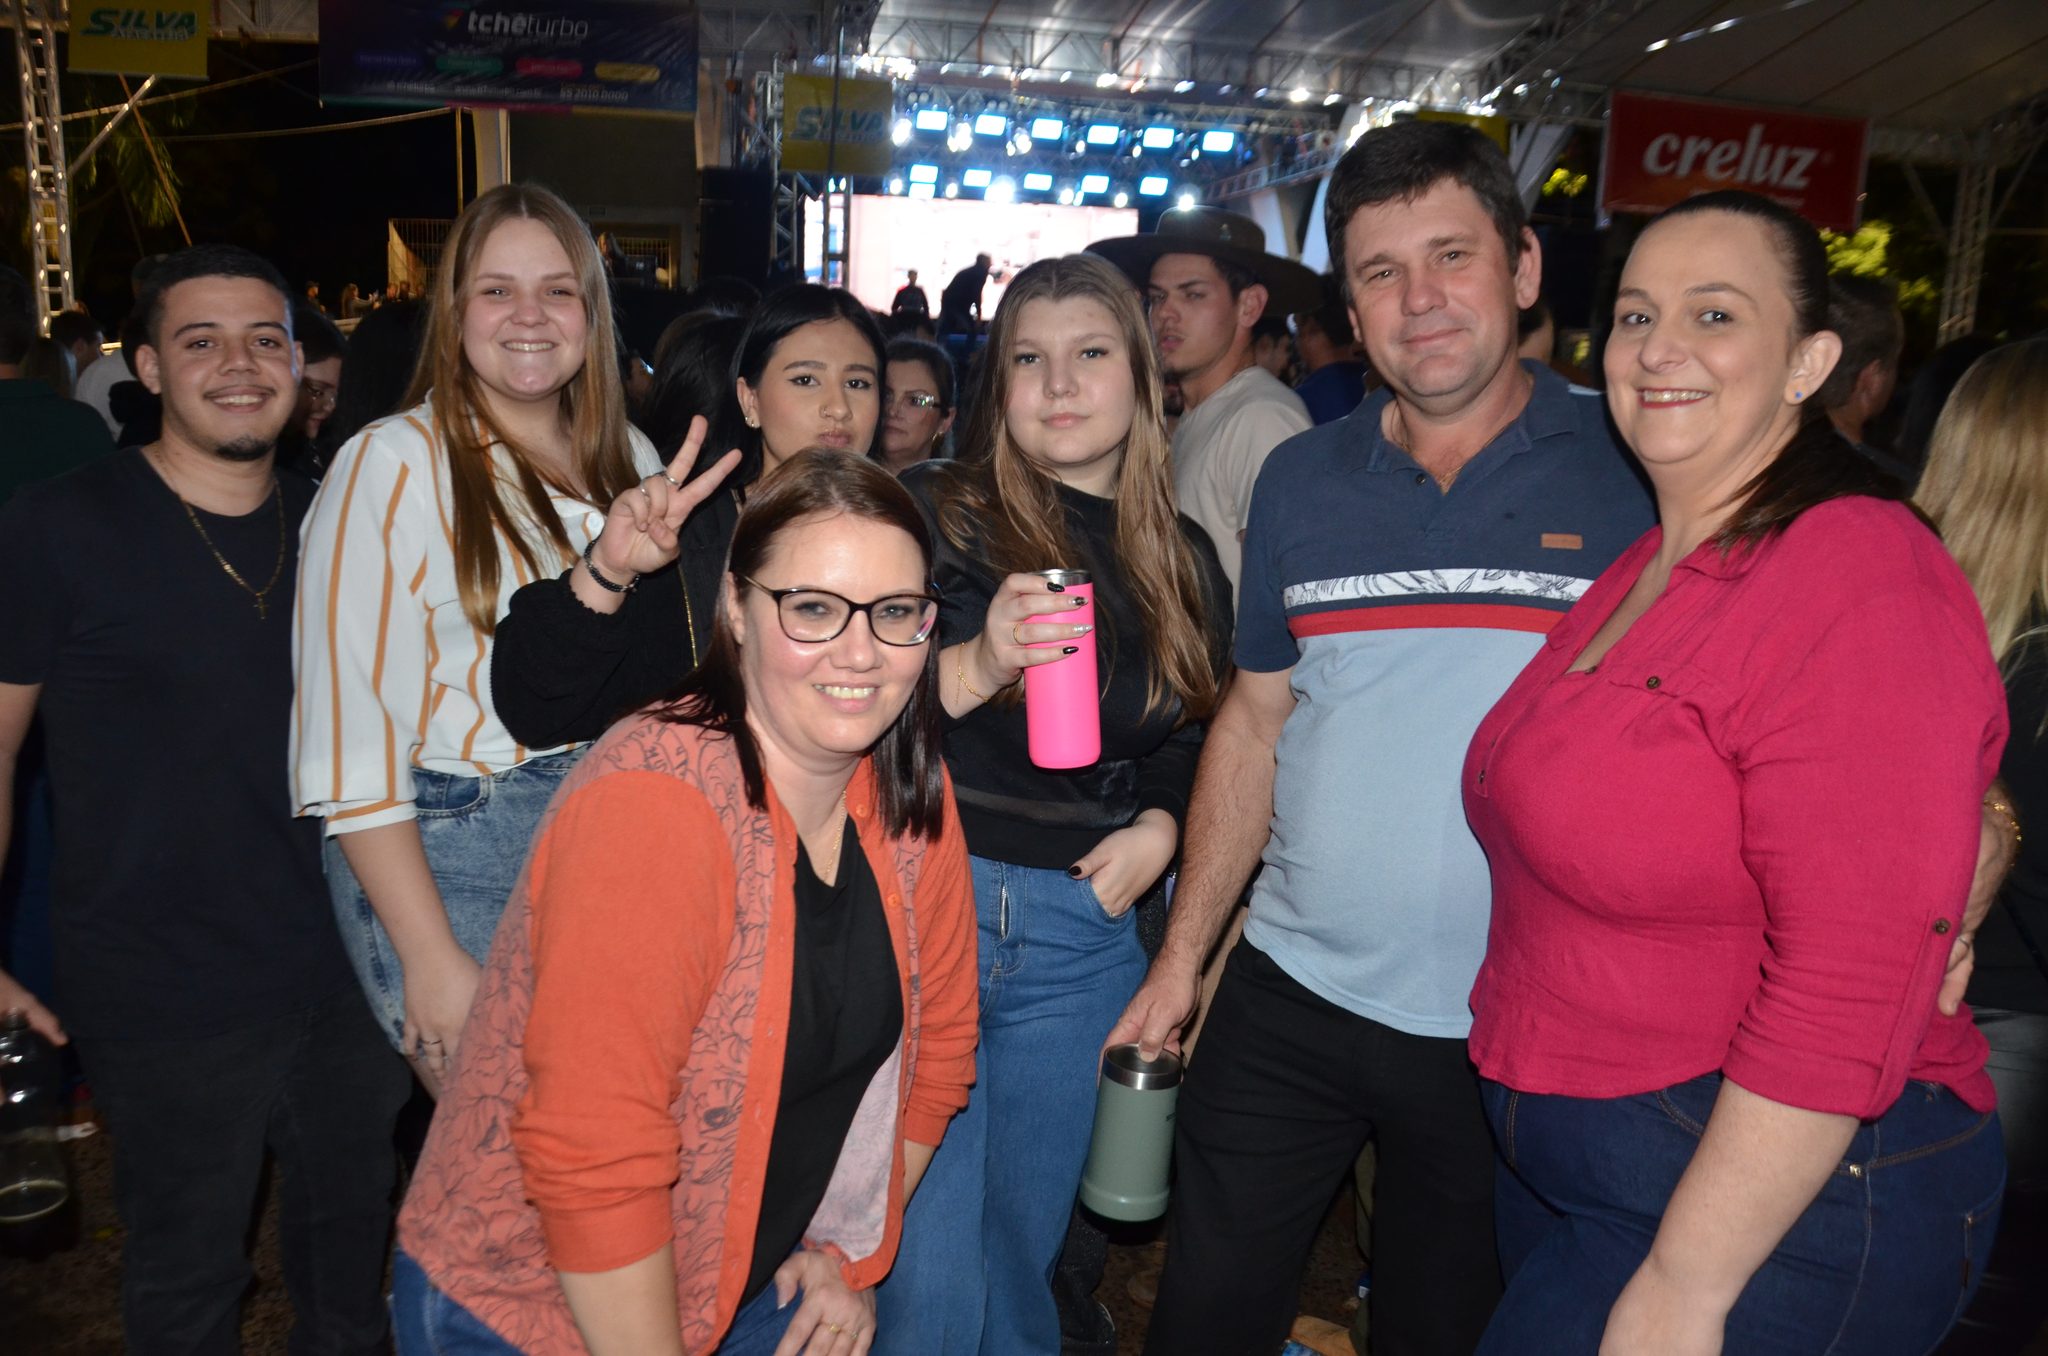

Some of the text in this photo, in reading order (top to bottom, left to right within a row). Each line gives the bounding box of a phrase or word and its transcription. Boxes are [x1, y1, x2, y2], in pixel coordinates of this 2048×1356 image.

[80, 8, 197, 36] SILVA
[789, 106, 884, 139] SILVA
[1643, 123, 1818, 189] creluz
